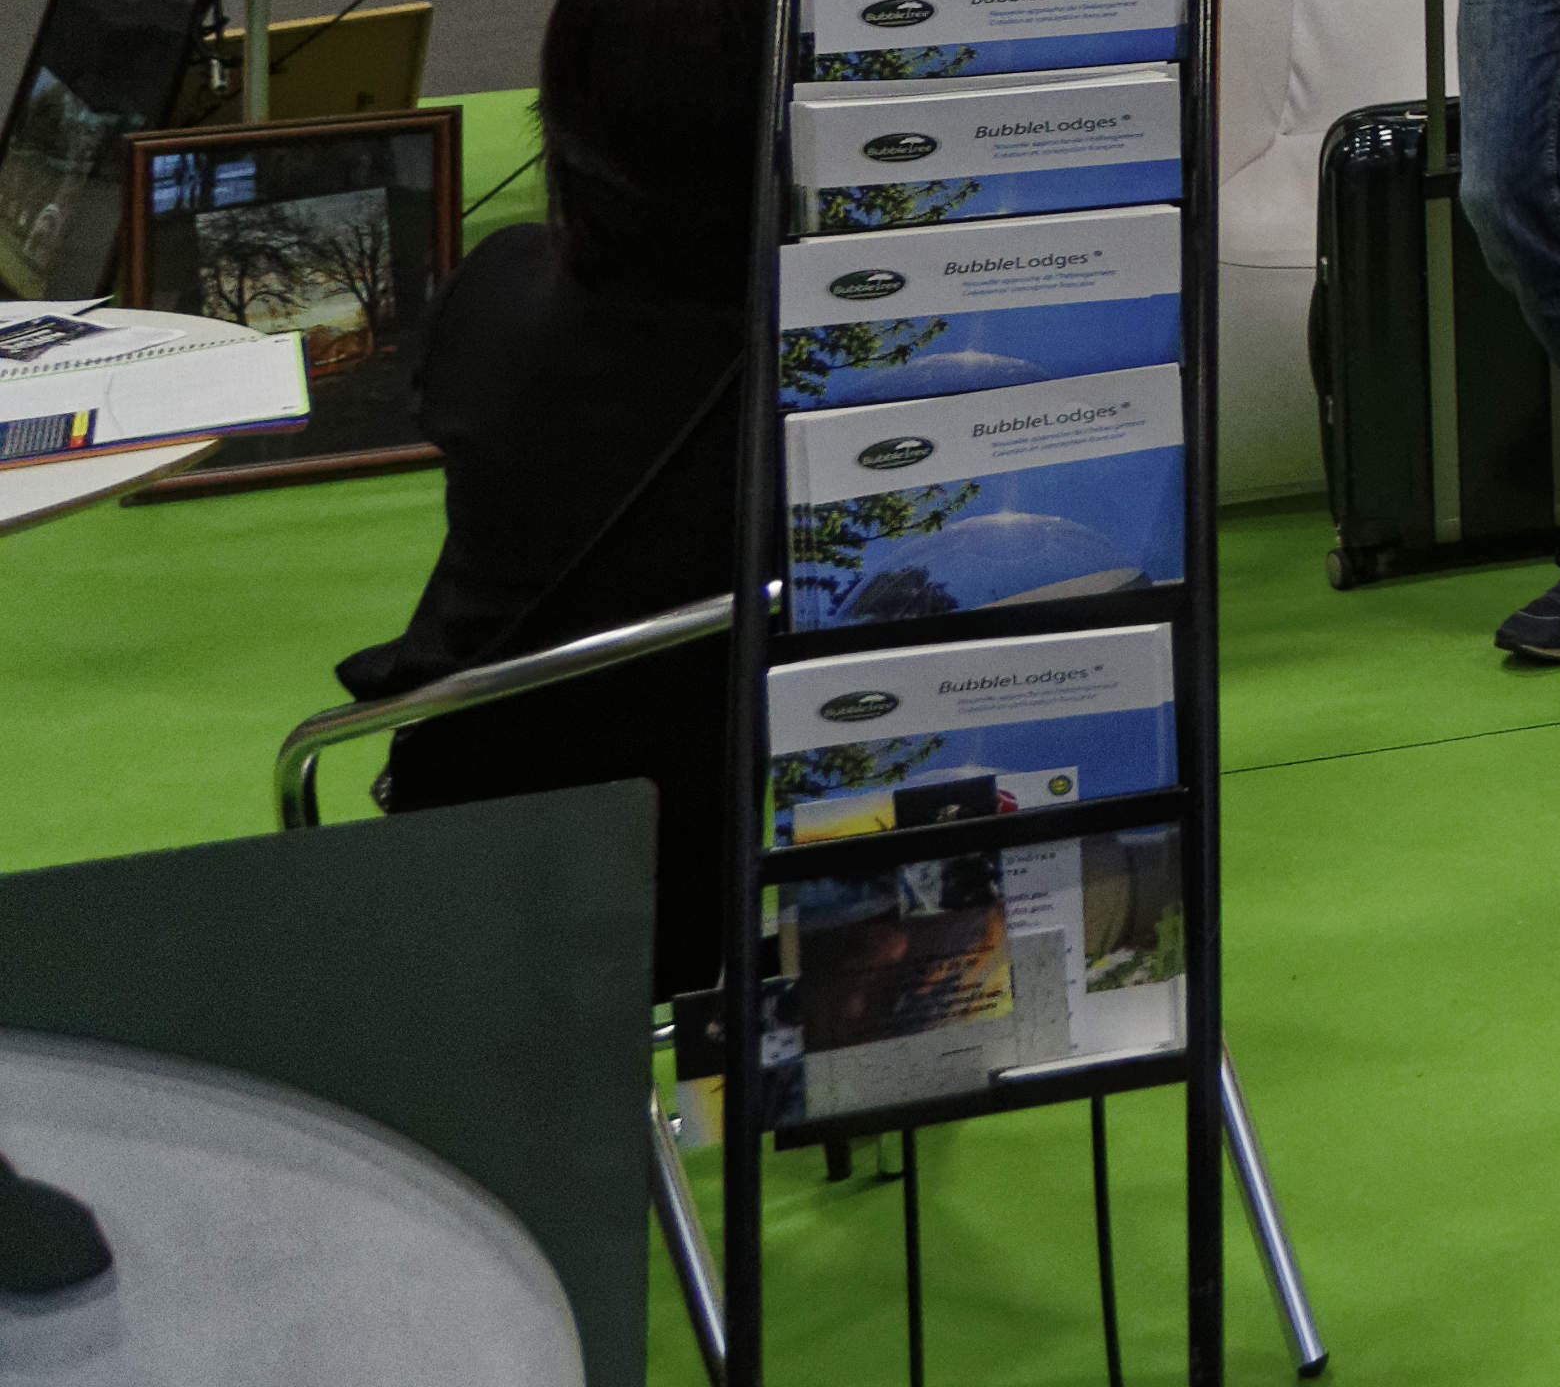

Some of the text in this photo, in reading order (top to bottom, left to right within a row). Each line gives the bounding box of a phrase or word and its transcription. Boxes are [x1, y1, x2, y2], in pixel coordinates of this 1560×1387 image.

[974, 115, 1117, 140] BubbleLodges
[944, 251, 1088, 276] BubbleLodges
[972, 404, 1118, 438] BubbleLodges
[938, 667, 1089, 695] BubbleLodges
